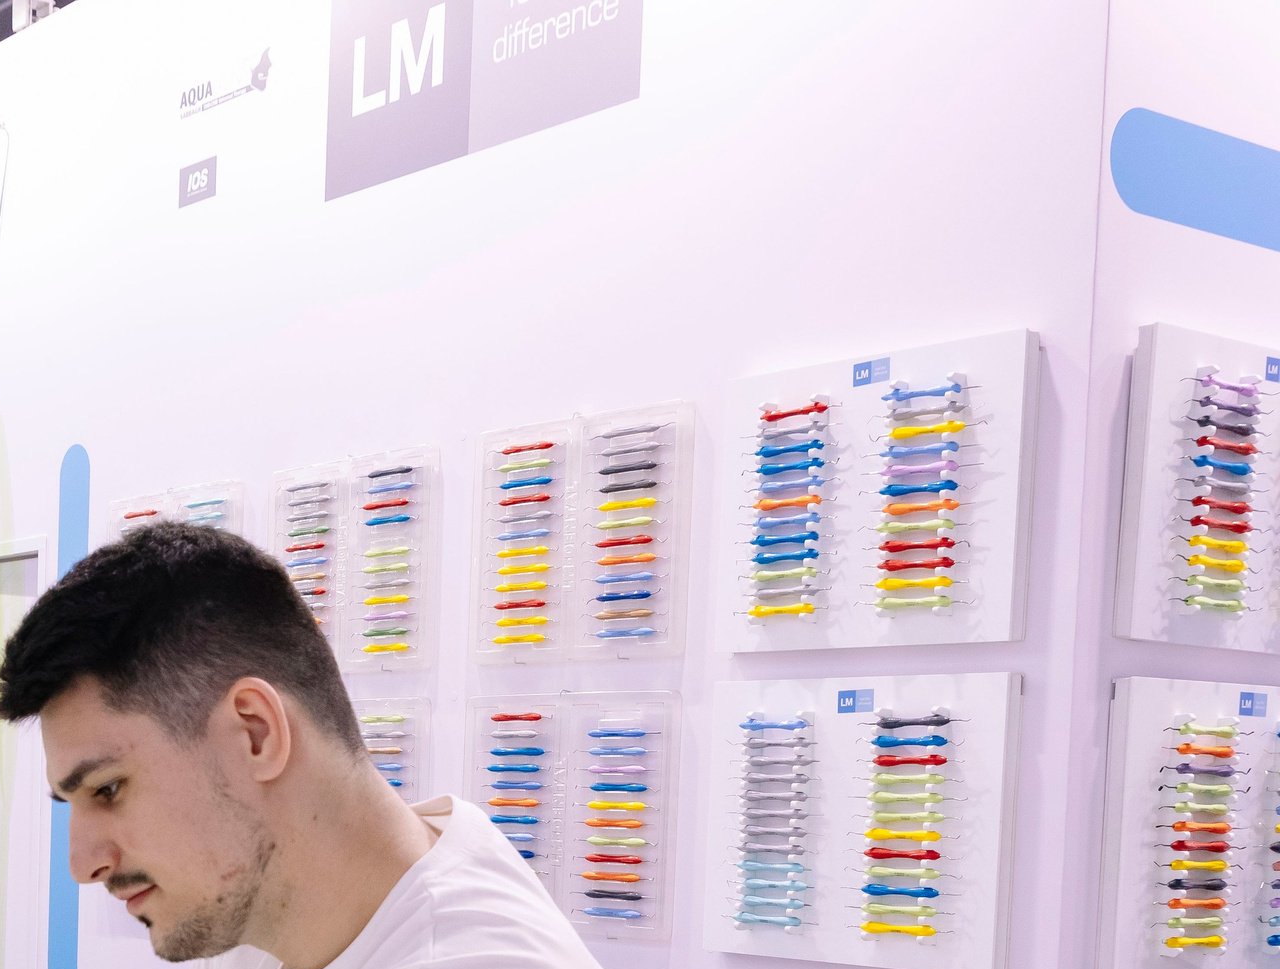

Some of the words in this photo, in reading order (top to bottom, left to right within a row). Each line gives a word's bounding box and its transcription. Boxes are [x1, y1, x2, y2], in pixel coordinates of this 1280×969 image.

[492, 0, 619, 63] difference
[352, 2, 446, 118] LM
[856, 369, 869, 380] LM
[840, 697, 853, 707] LM
[1241, 699, 1252, 709] LM
